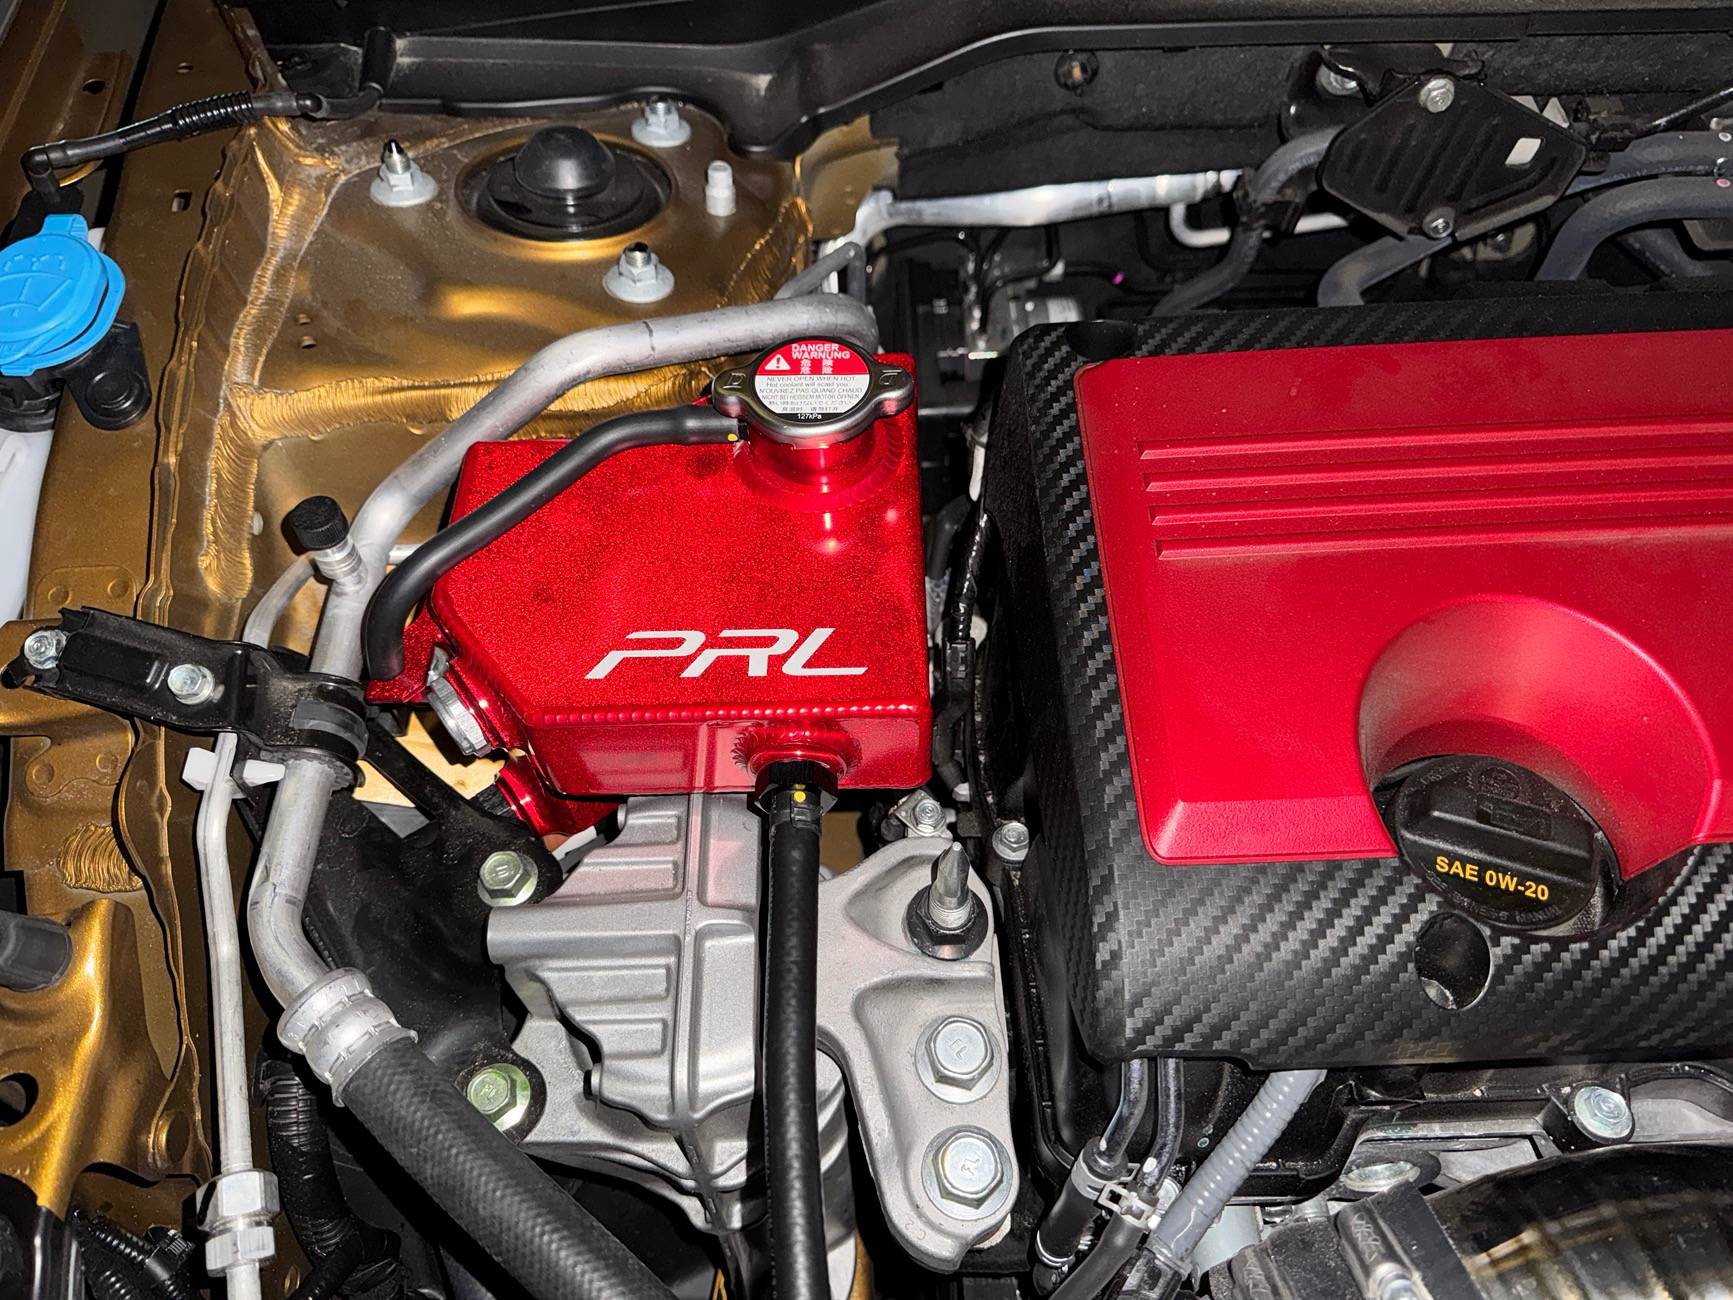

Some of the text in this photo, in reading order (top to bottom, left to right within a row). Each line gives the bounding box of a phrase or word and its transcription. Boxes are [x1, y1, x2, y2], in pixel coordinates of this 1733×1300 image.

[791, 343, 840, 352] DANGER
[791, 351, 851, 360] WARNUNG
[583, 627, 868, 680] PRL
[1434, 855, 1550, 902] SAE 0W-20
